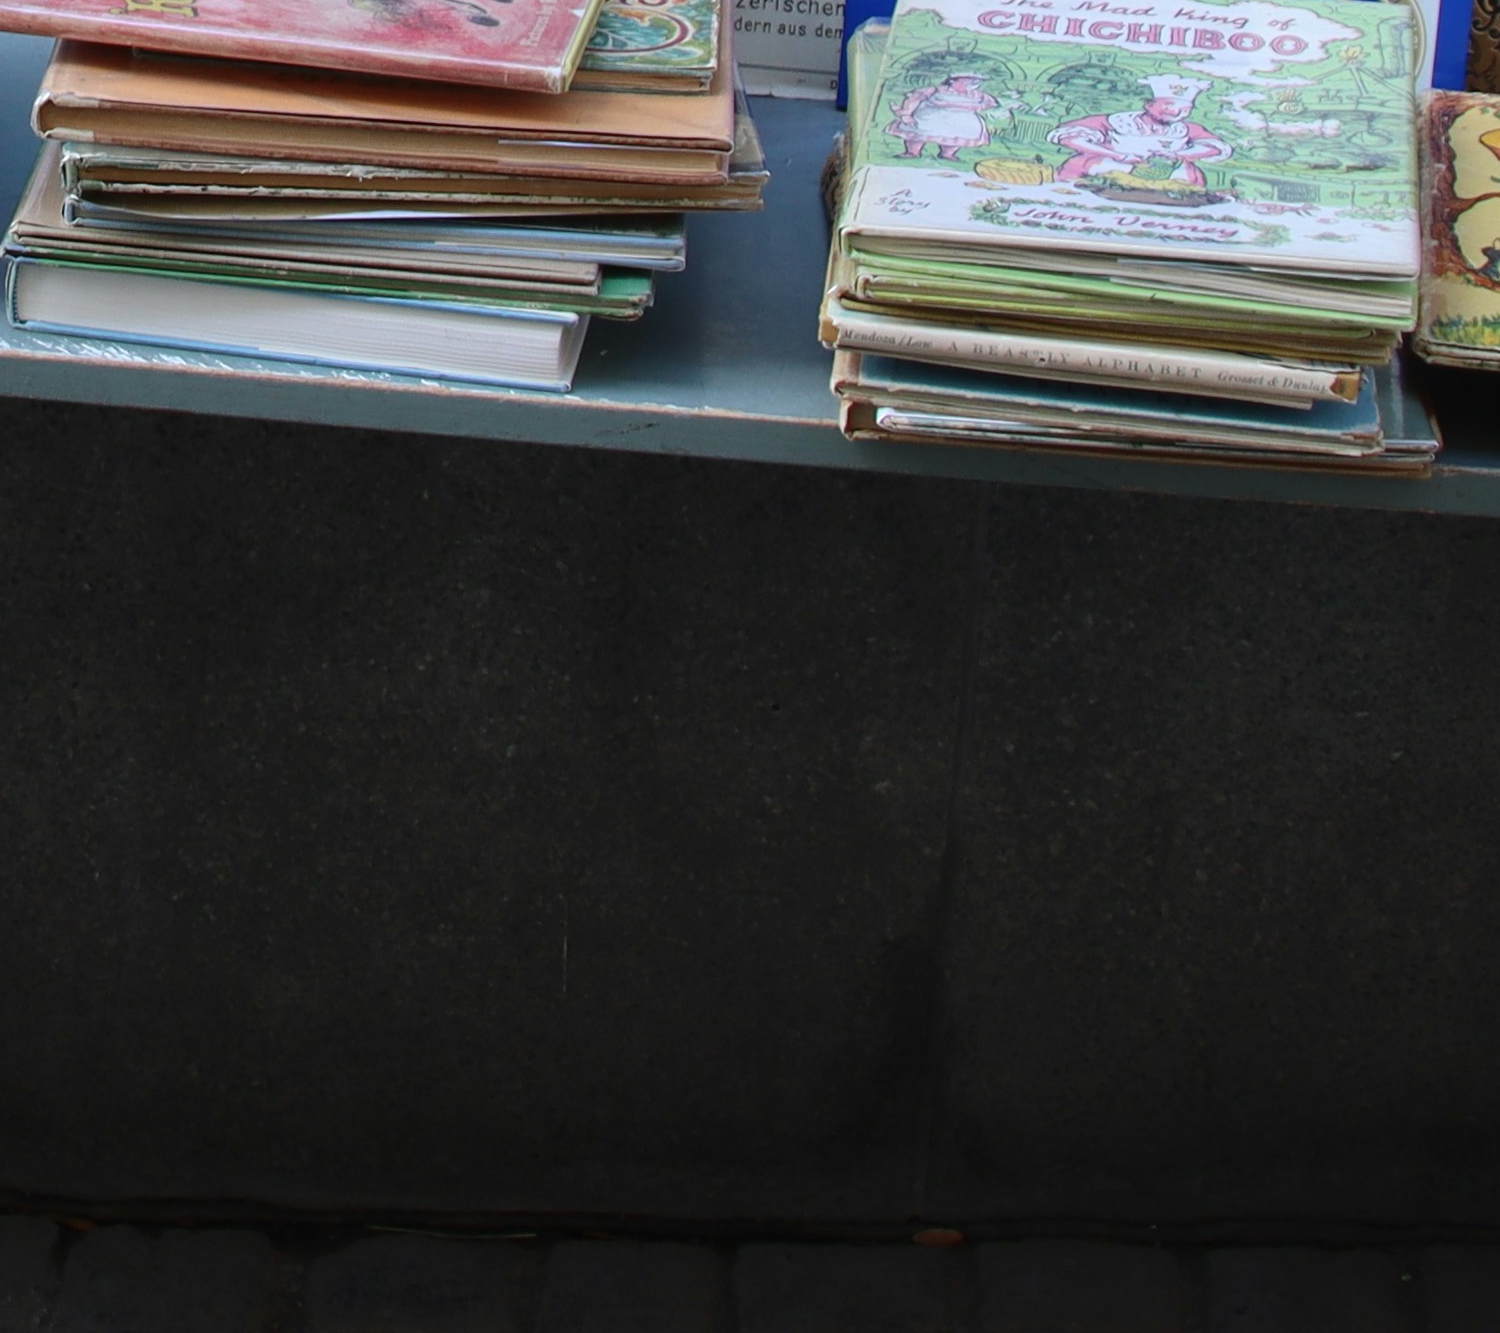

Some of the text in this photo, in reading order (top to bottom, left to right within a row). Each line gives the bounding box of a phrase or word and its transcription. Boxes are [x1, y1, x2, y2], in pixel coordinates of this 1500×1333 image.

[778, 23, 806, 37] aus
[1072, 0, 1157, 19] Mad
[1174, 6, 1250, 31] King
[1268, 16, 1298, 31] of
[977, 8, 1310, 56] CHICHIBOO
[1013, 206, 1240, 238] John Verney
[948, 341, 960, 352] A
[1081, 355, 1203, 378] ALPHABET
[1217, 368, 1265, 387] Grosset
[1266, 373, 1278, 388] &
